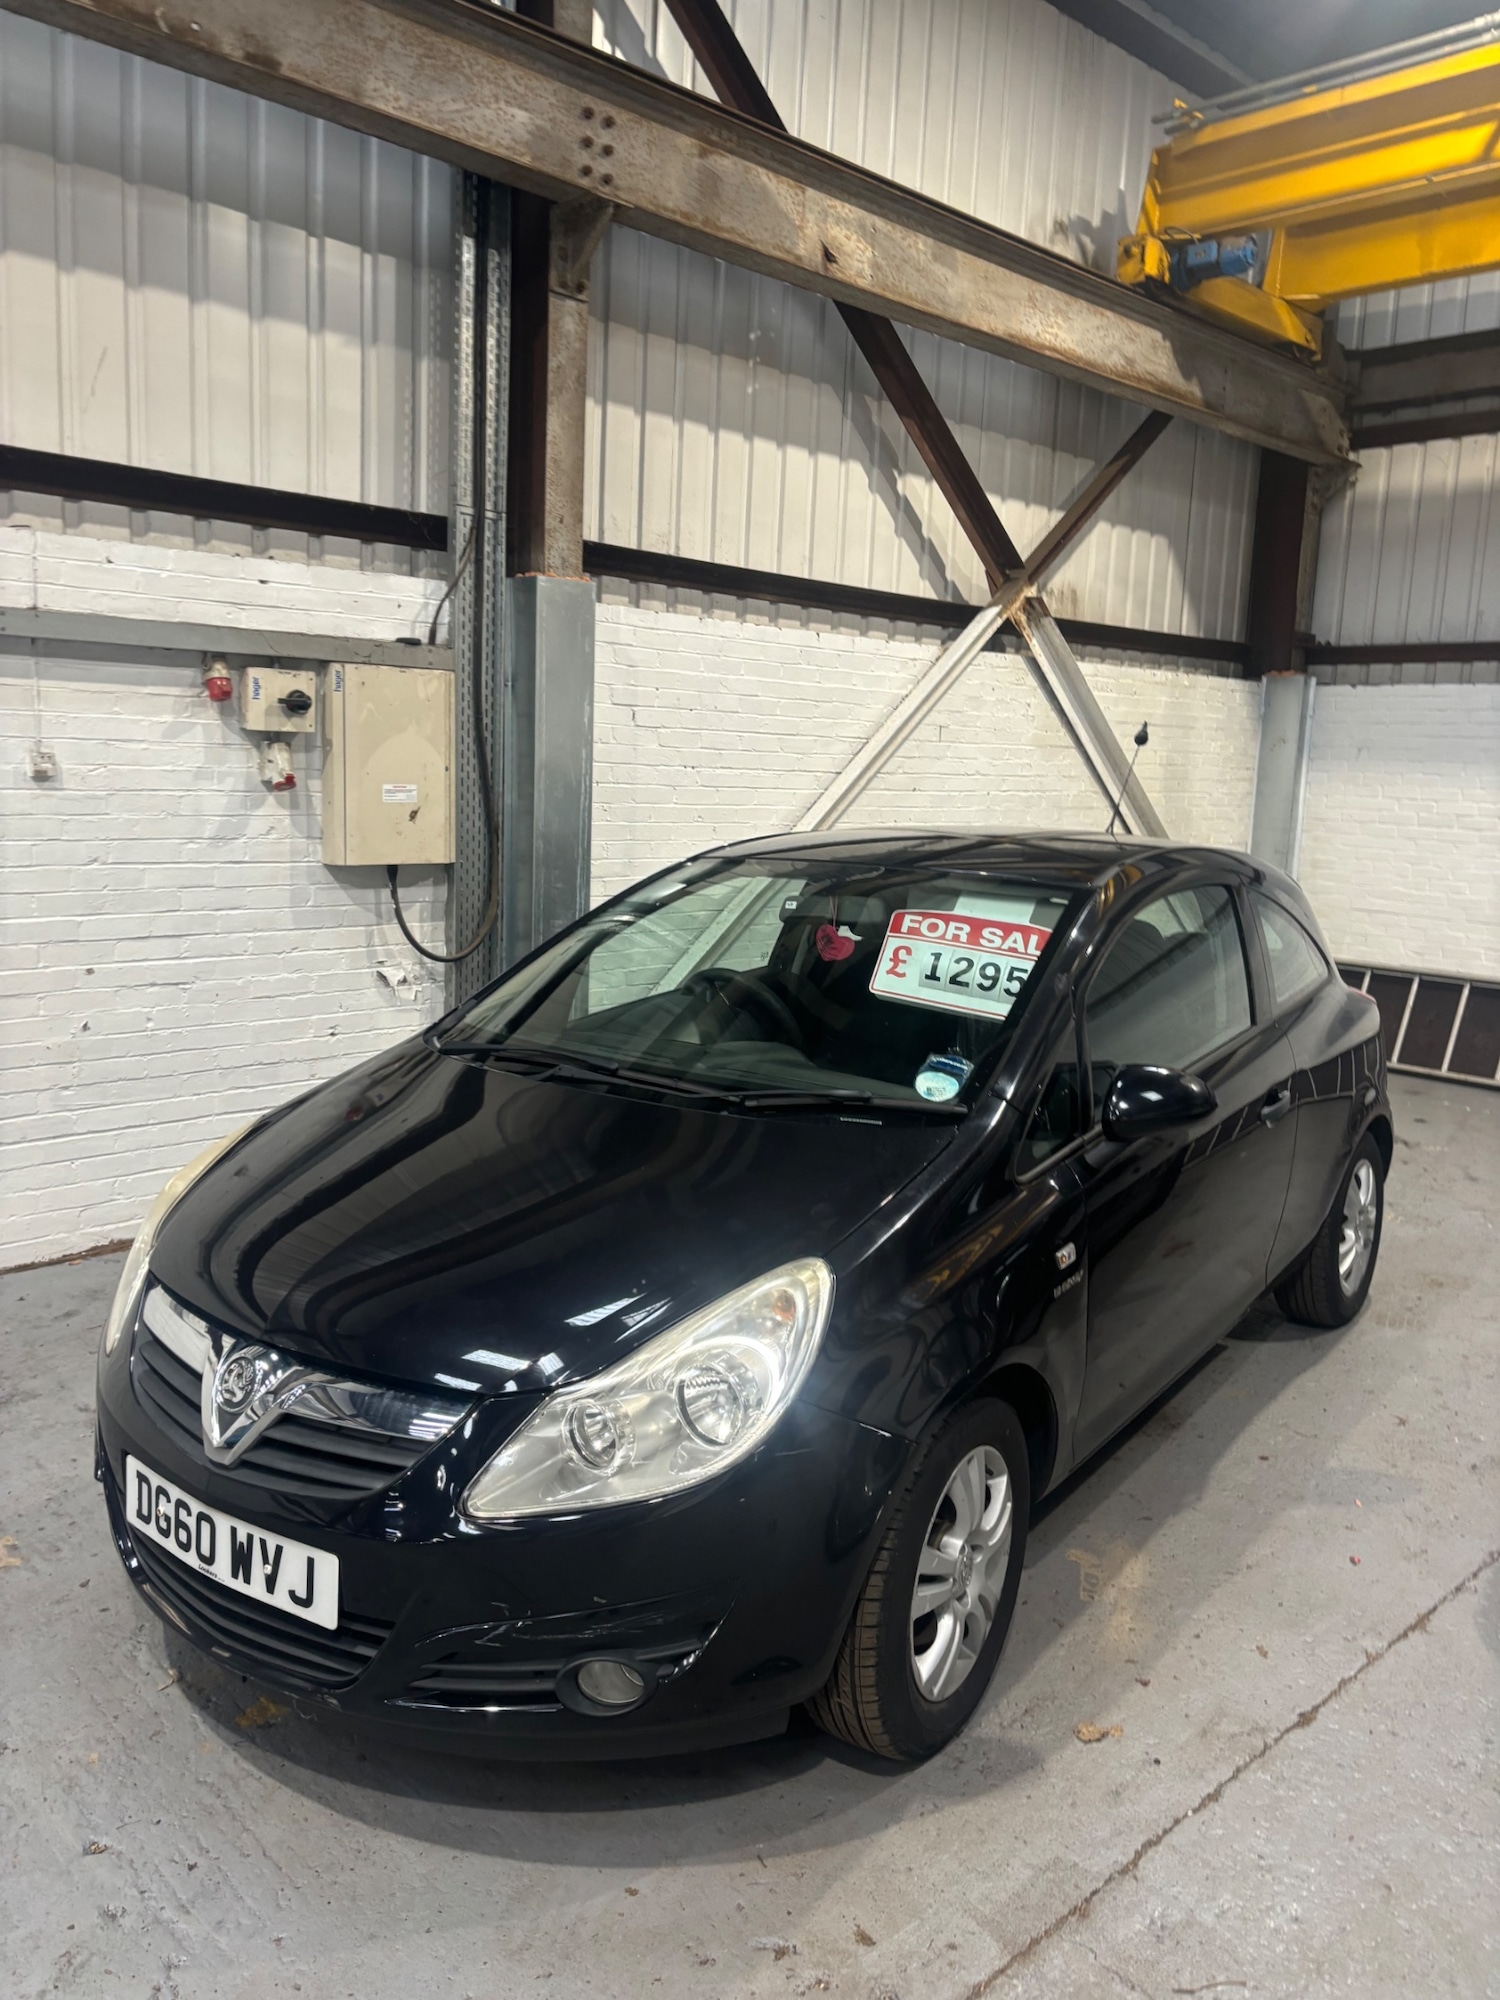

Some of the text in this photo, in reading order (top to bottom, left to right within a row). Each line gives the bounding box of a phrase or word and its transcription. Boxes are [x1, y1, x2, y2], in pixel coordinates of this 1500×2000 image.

[251, 676, 261, 700] hager
[333, 668, 343, 693] hager
[901, 914, 1042, 955] FOR SAL
[886, 945, 1029, 998] £ 1295
[136, 1469, 315, 1609] DG60 WVJ
